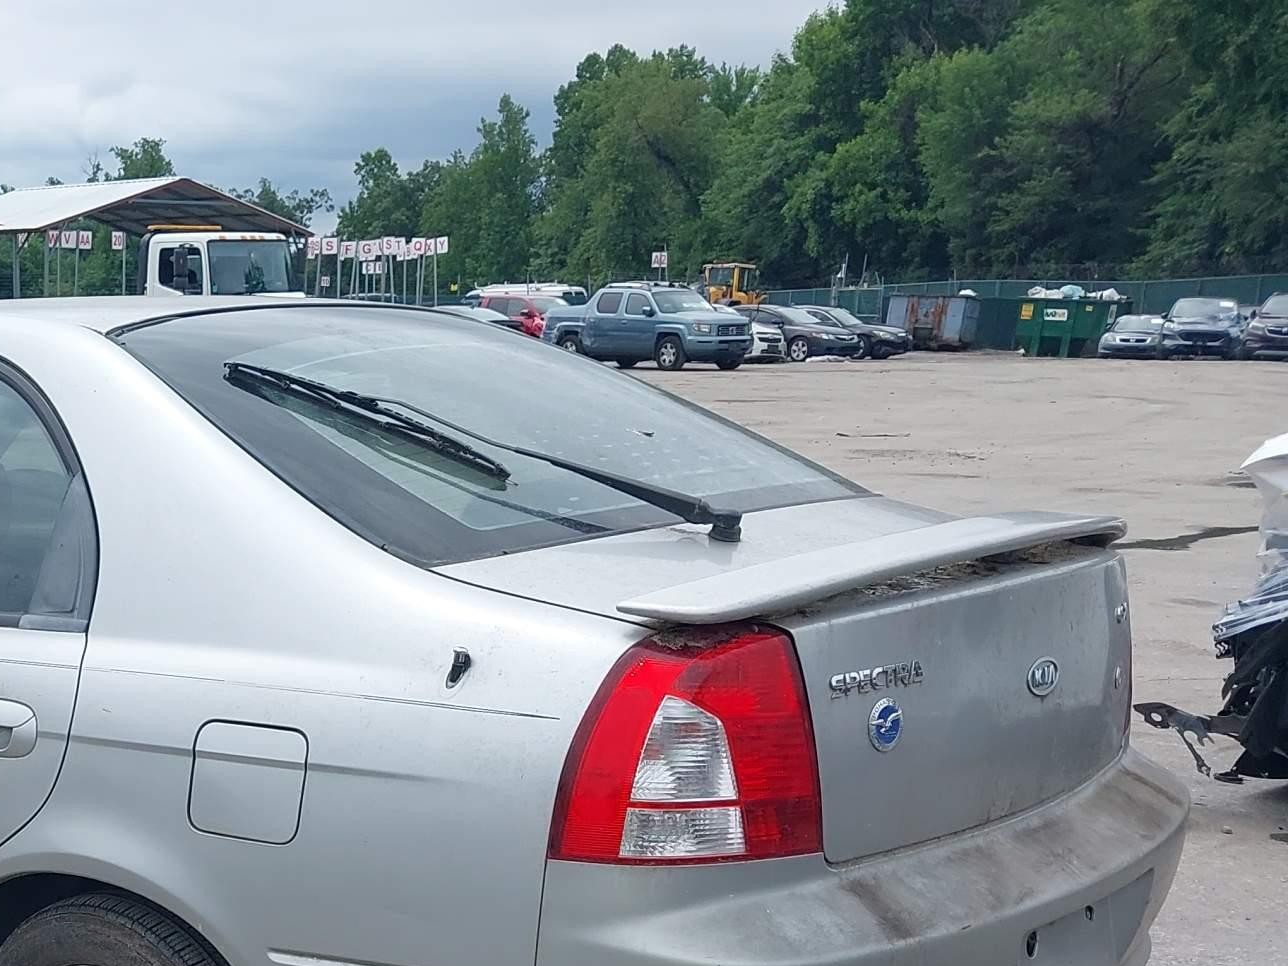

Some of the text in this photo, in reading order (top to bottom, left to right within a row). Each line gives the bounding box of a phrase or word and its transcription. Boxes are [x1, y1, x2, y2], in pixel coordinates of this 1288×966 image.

[63, 233, 71, 244] V
[79, 234, 90, 246] AA
[113, 234, 122, 246] 20
[385, 239, 392, 249] S
[325, 241, 333, 252] S
[345, 245, 352, 255] F
[362, 243, 371, 254] G
[395, 240, 402, 250] T
[414, 241, 422, 252] Q
[438, 239, 446, 250] Y
[829, 660, 924, 699] SPECTRA
